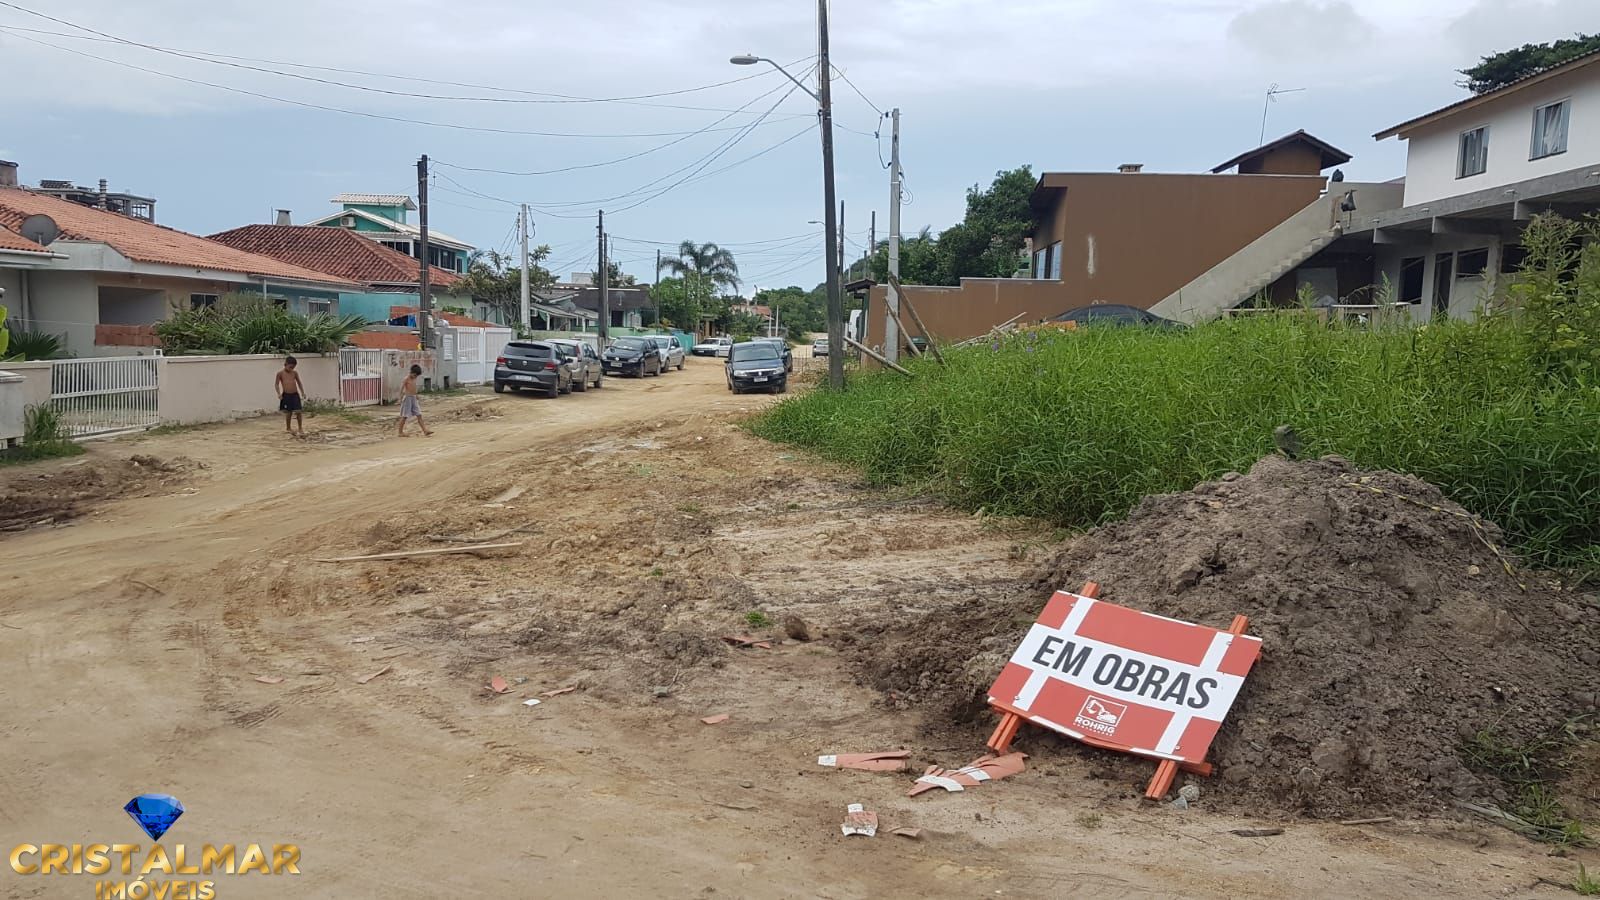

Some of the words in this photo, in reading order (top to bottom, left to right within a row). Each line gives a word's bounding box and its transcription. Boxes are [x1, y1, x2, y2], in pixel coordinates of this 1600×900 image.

[1032, 635, 1093, 677] EM
[1092, 653, 1218, 709] OBRAS
[1074, 716, 1116, 734] ROHRIG
